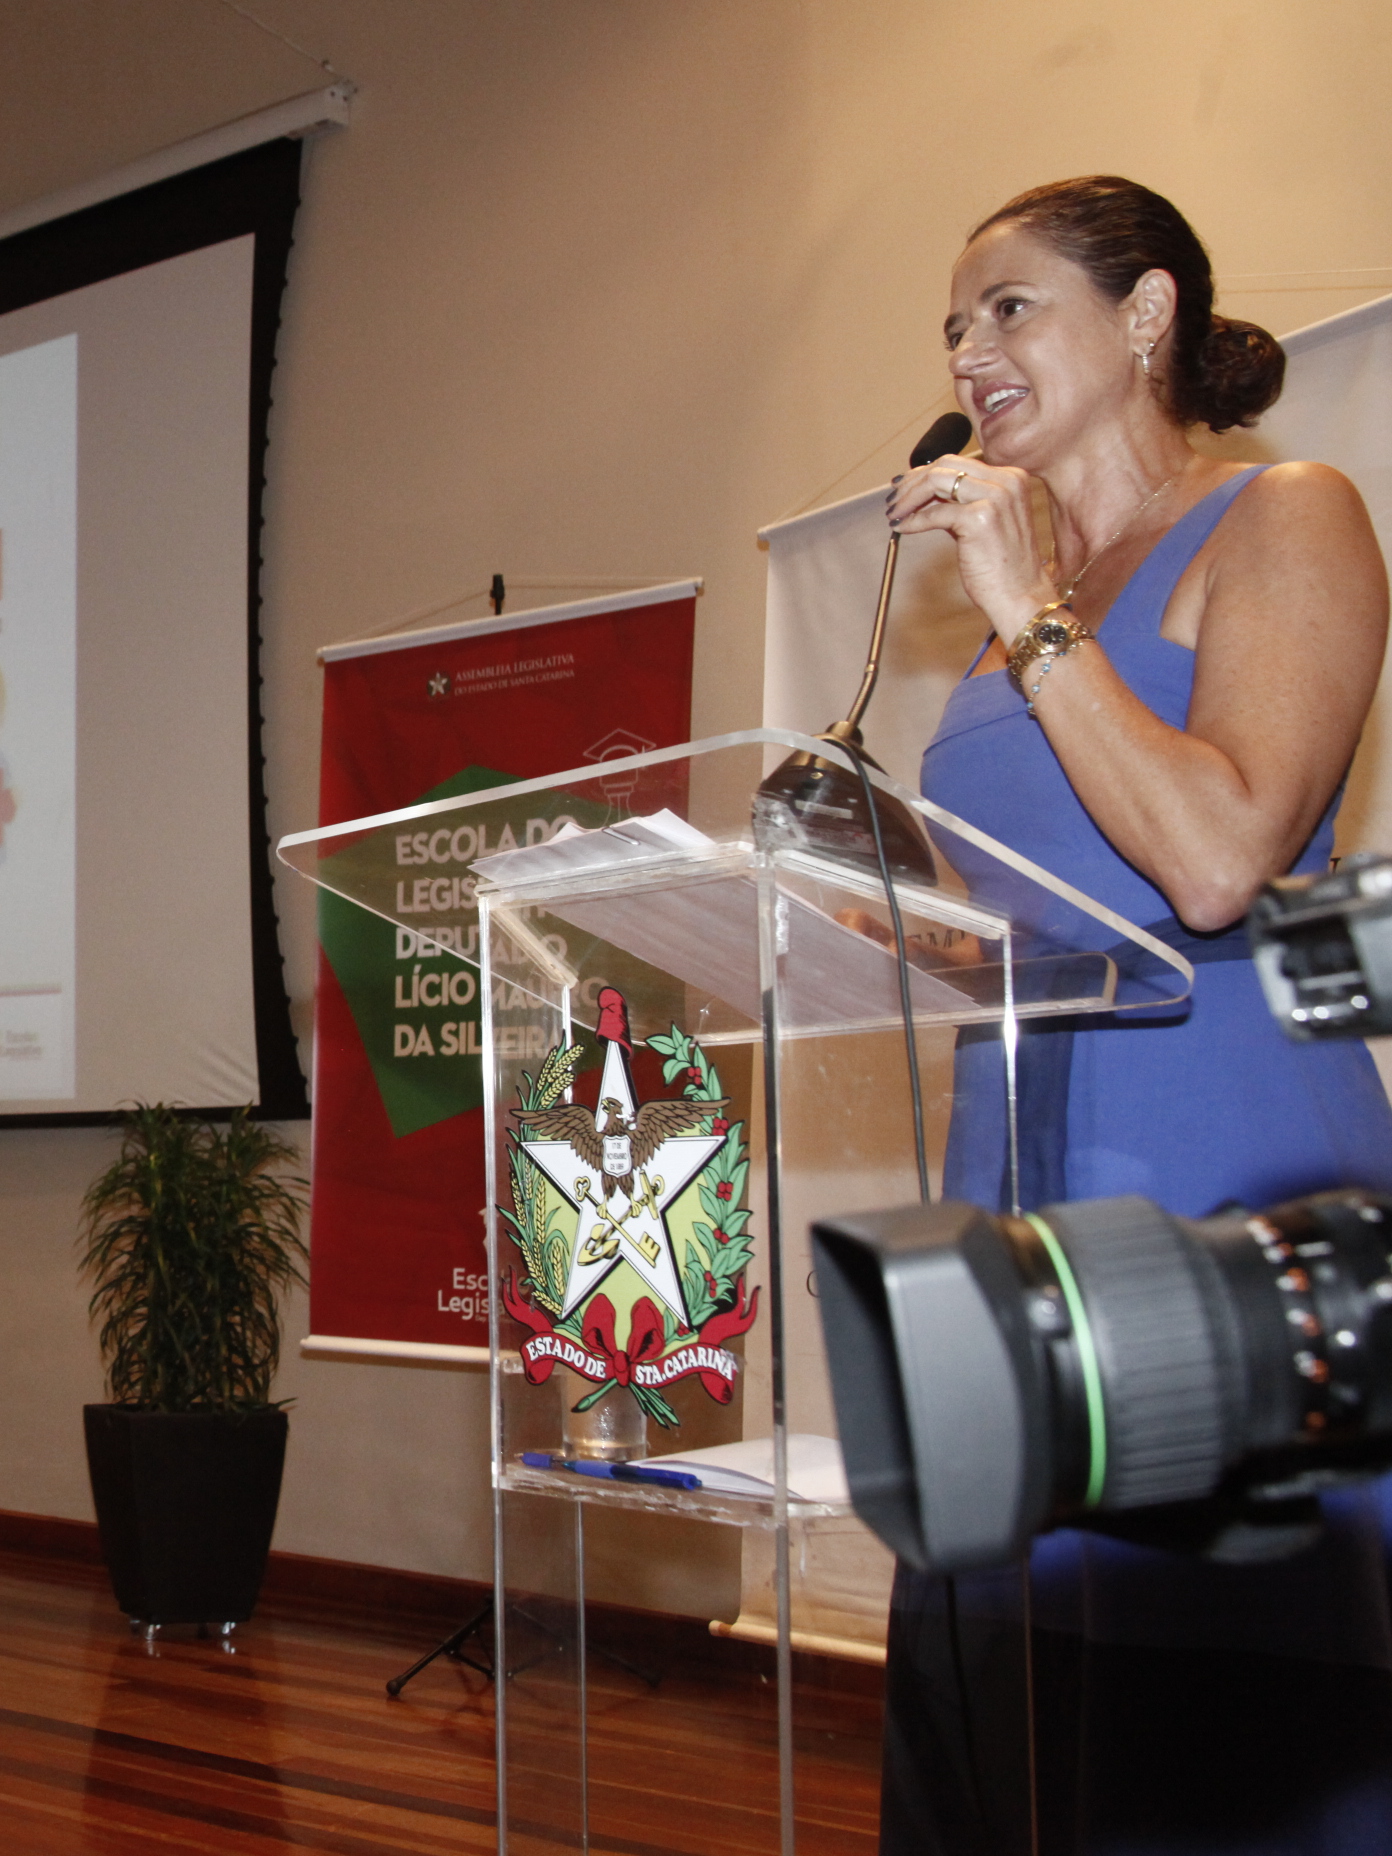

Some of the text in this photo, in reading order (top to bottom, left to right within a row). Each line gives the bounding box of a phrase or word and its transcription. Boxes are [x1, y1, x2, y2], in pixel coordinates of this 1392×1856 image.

[455, 652, 575, 682] ASSEMBLEIA LEGISLATIVA
[510, 675, 534, 687] SANTA
[535, 669, 575, 683] CATARINA
[395, 823, 519, 866] ESCOLA
[394, 964, 476, 1008] LÍCIO
[393, 1023, 436, 1057] DA
[525, 1336, 586, 1368] ESTADO
[584, 1357, 607, 1379] DE
